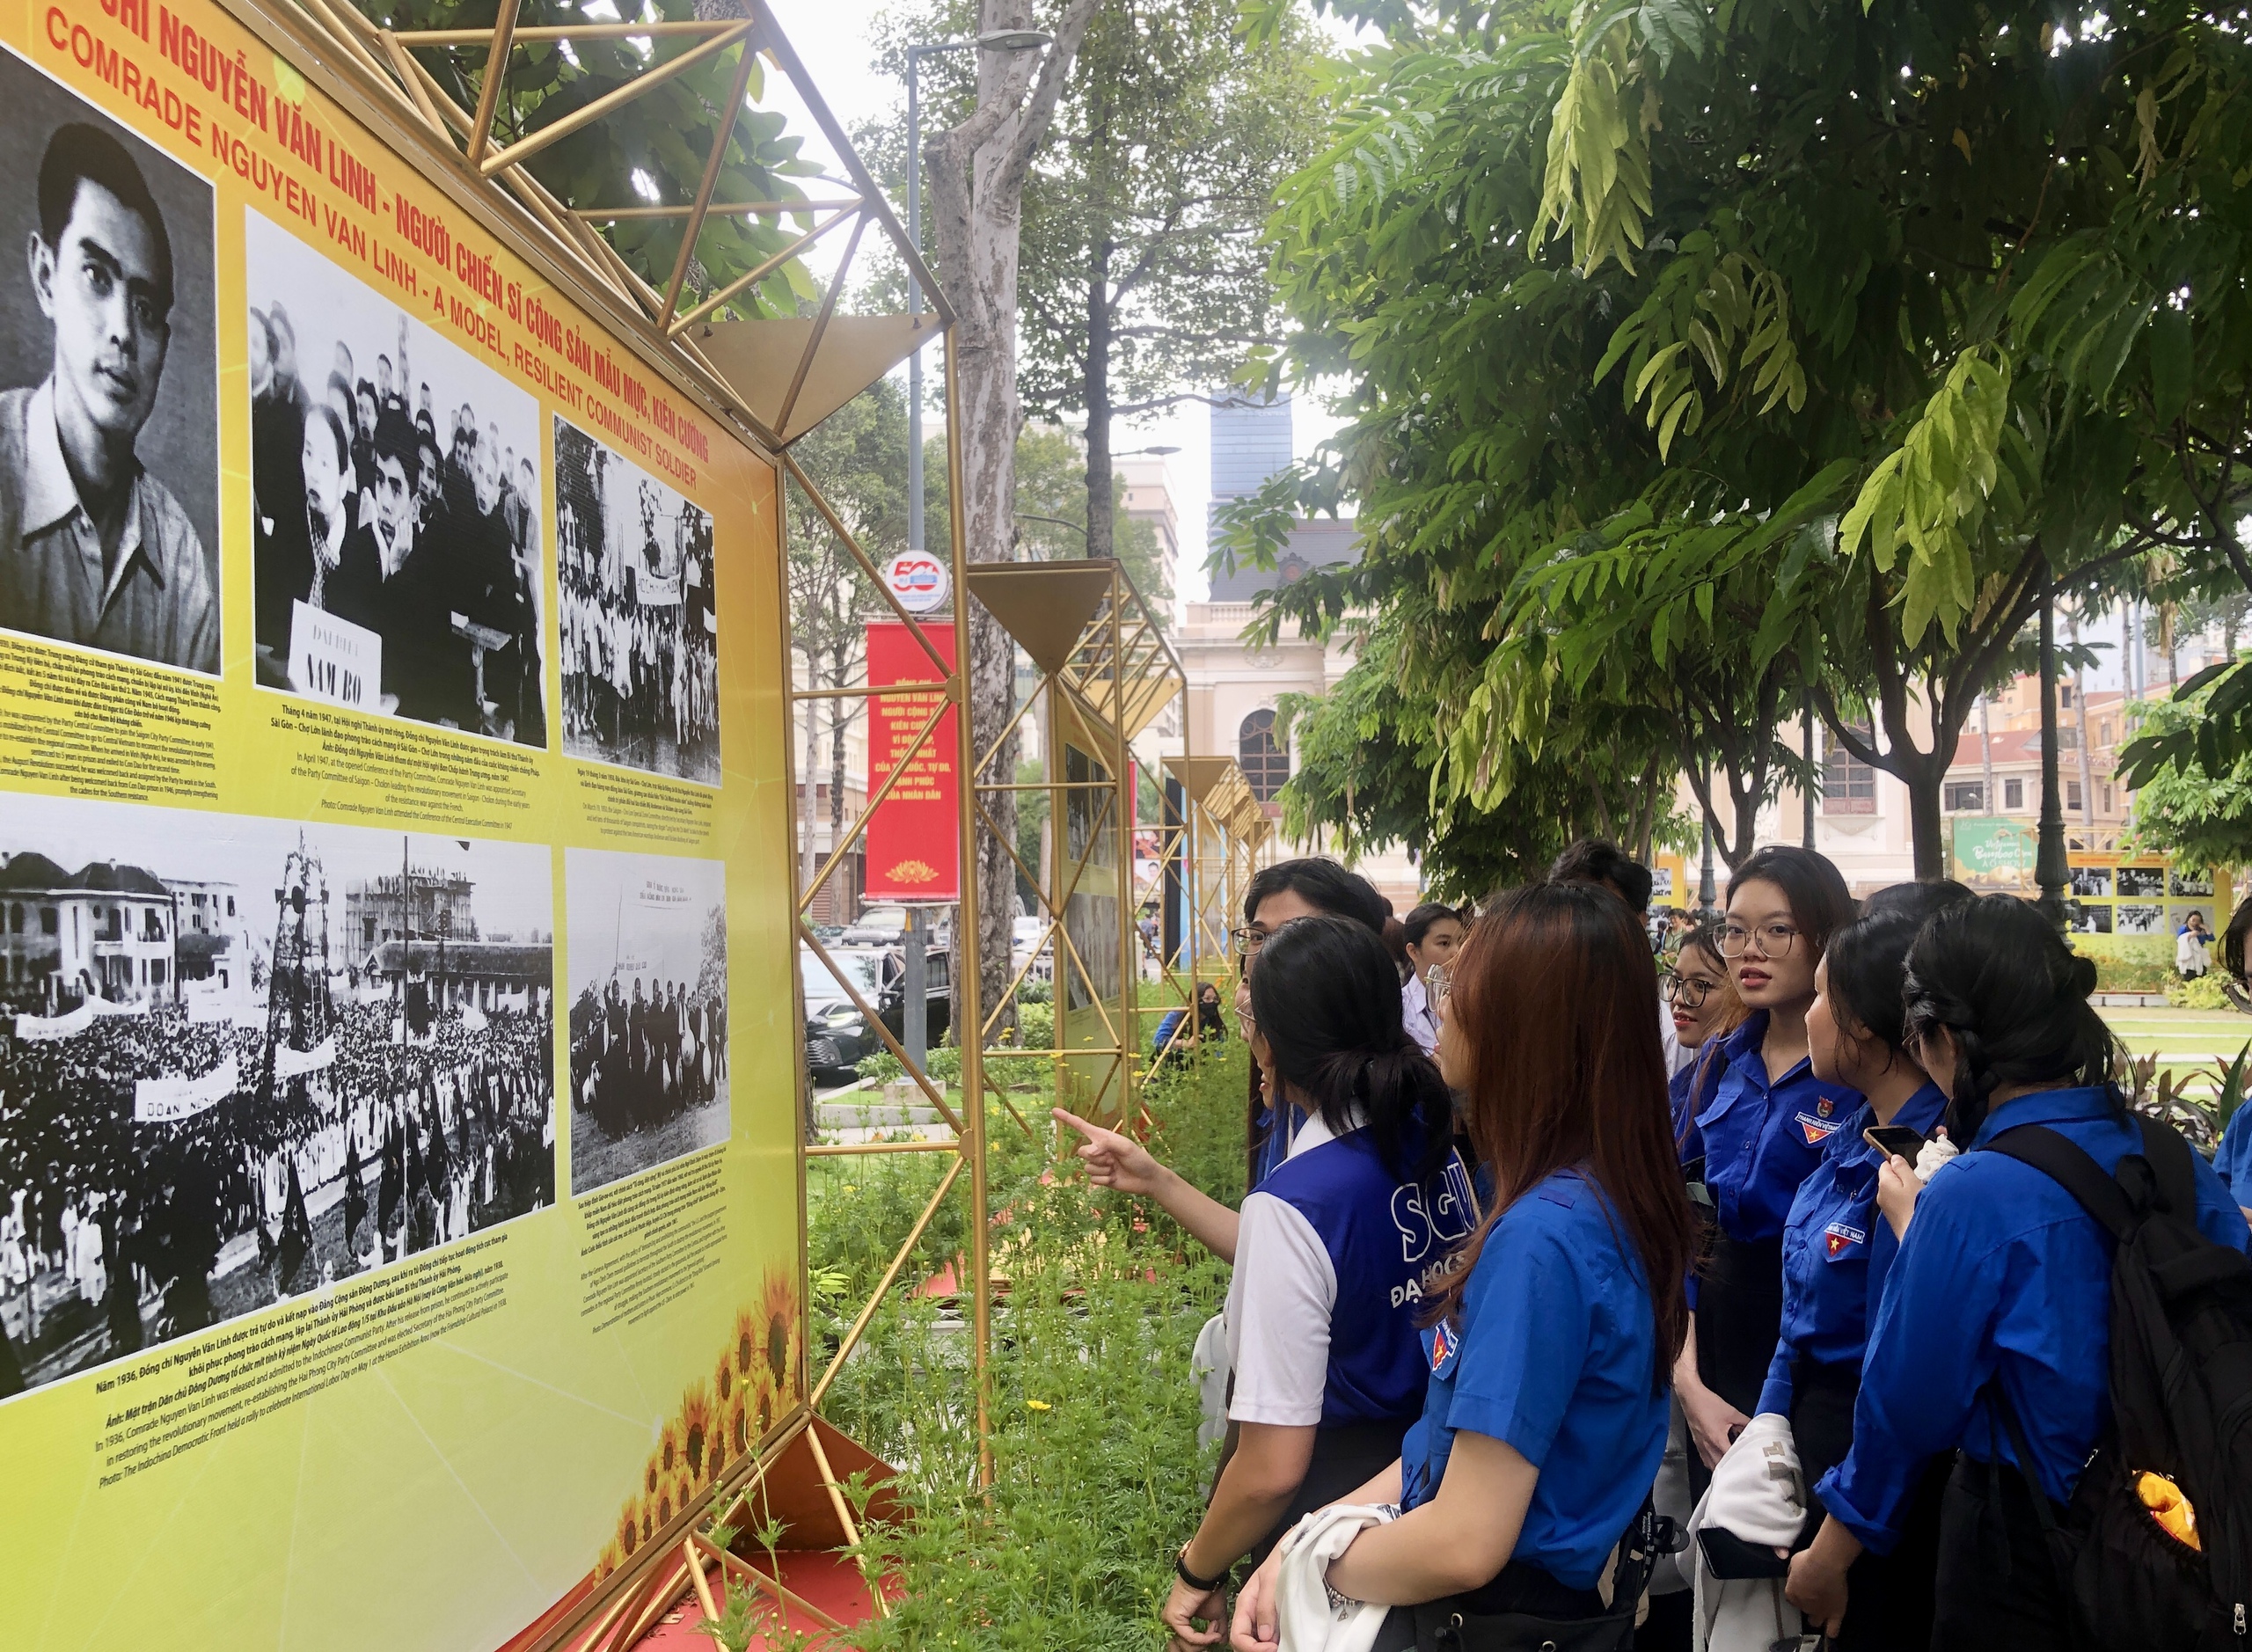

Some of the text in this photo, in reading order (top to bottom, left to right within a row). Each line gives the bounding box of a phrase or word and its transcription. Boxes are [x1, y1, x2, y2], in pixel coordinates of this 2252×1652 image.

[47, 7, 697, 491] COMRADE NGUYEN VAN LINH A MODEL, RESILIENT COMMUNIST SOLDIER
[159, 4, 267, 134] NGUYỄN
[274, 96, 322, 175] VĂN
[329, 139, 377, 216] LINH
[396, 193, 450, 270] NGƯỜI
[457, 242, 503, 312] CHIẾN
[508, 277, 522, 324] SĨ
[527, 297, 562, 357] CỘNG
[566, 325, 592, 375] SẢN
[595, 346, 620, 398] MẪU
[624, 371, 651, 424] MỰC,
[653, 398, 676, 442] KIÊN
[678, 421, 709, 464] CƯỜNG
[297, 767, 306, 776] the
[308, 768, 320, 780] Party
[321, 771, 347, 782] Committee
[355, 775, 369, 786] Saigon
[303, 753, 315, 764] April
[96, 1381, 114, 1393] Năm
[117, 1371, 137, 1385] 1936,
[139, 1363, 159, 1378] Đồng
[162, 1356, 172, 1369] chí
[173, 1347, 201, 1365] Nguyễn
[202, 1342, 215, 1354] Văn
[216, 1335, 230, 1349] Linh
[232, 1331, 247, 1342] được
[267, 1319, 275, 1329] do
[277, 1316, 283, 1326] và
[308, 1305, 318, 1314] vào
[189, 1363, 204, 1377] khôi
[206, 1358, 222, 1372] phục
[223, 1349, 245, 1366] phong
[246, 1343, 259, 1354] trào
[260, 1336, 274, 1349] cách
[314, 1314, 330, 1328] Thành
[95, 1442, 102, 1452] In
[106, 1432, 124, 1447] 1936,
[126, 1418, 158, 1438] Comrade
[160, 1408, 186, 1425] Nguyen
[188, 1402, 200, 1413] Van
[201, 1394, 215, 1407] Linh
[216, 1390, 229, 1400] was
[230, 1377, 255, 1395] released
[256, 1371, 267, 1385] and
[269, 1360, 294, 1379] admitted
[296, 1358, 302, 1368] to
[303, 1356, 311, 1365] the
[312, 1342, 343, 1361] Indochinese
[344, 1330, 371, 1347] Communist
[106, 1457, 113, 1466] in
[115, 1443, 147, 1463] restoring
[150, 1436, 160, 1448] the
[163, 1417, 206, 1442] revolutionary
[208, 1400, 243, 1422] movement,
[245, 1383, 287, 1407] re-establishing
[288, 1378, 297, 1387] the
[309, 1366, 325, 1378] Phong
[326, 1361, 336, 1371] City
[337, 1355, 349, 1365] Party
[351, 1343, 377, 1359] Committee
[124, 1466, 135, 1477] The
[172, 1432, 208, 1456] Democratic
[210, 1424, 226, 1438] Front
[227, 1417, 239, 1431] held
